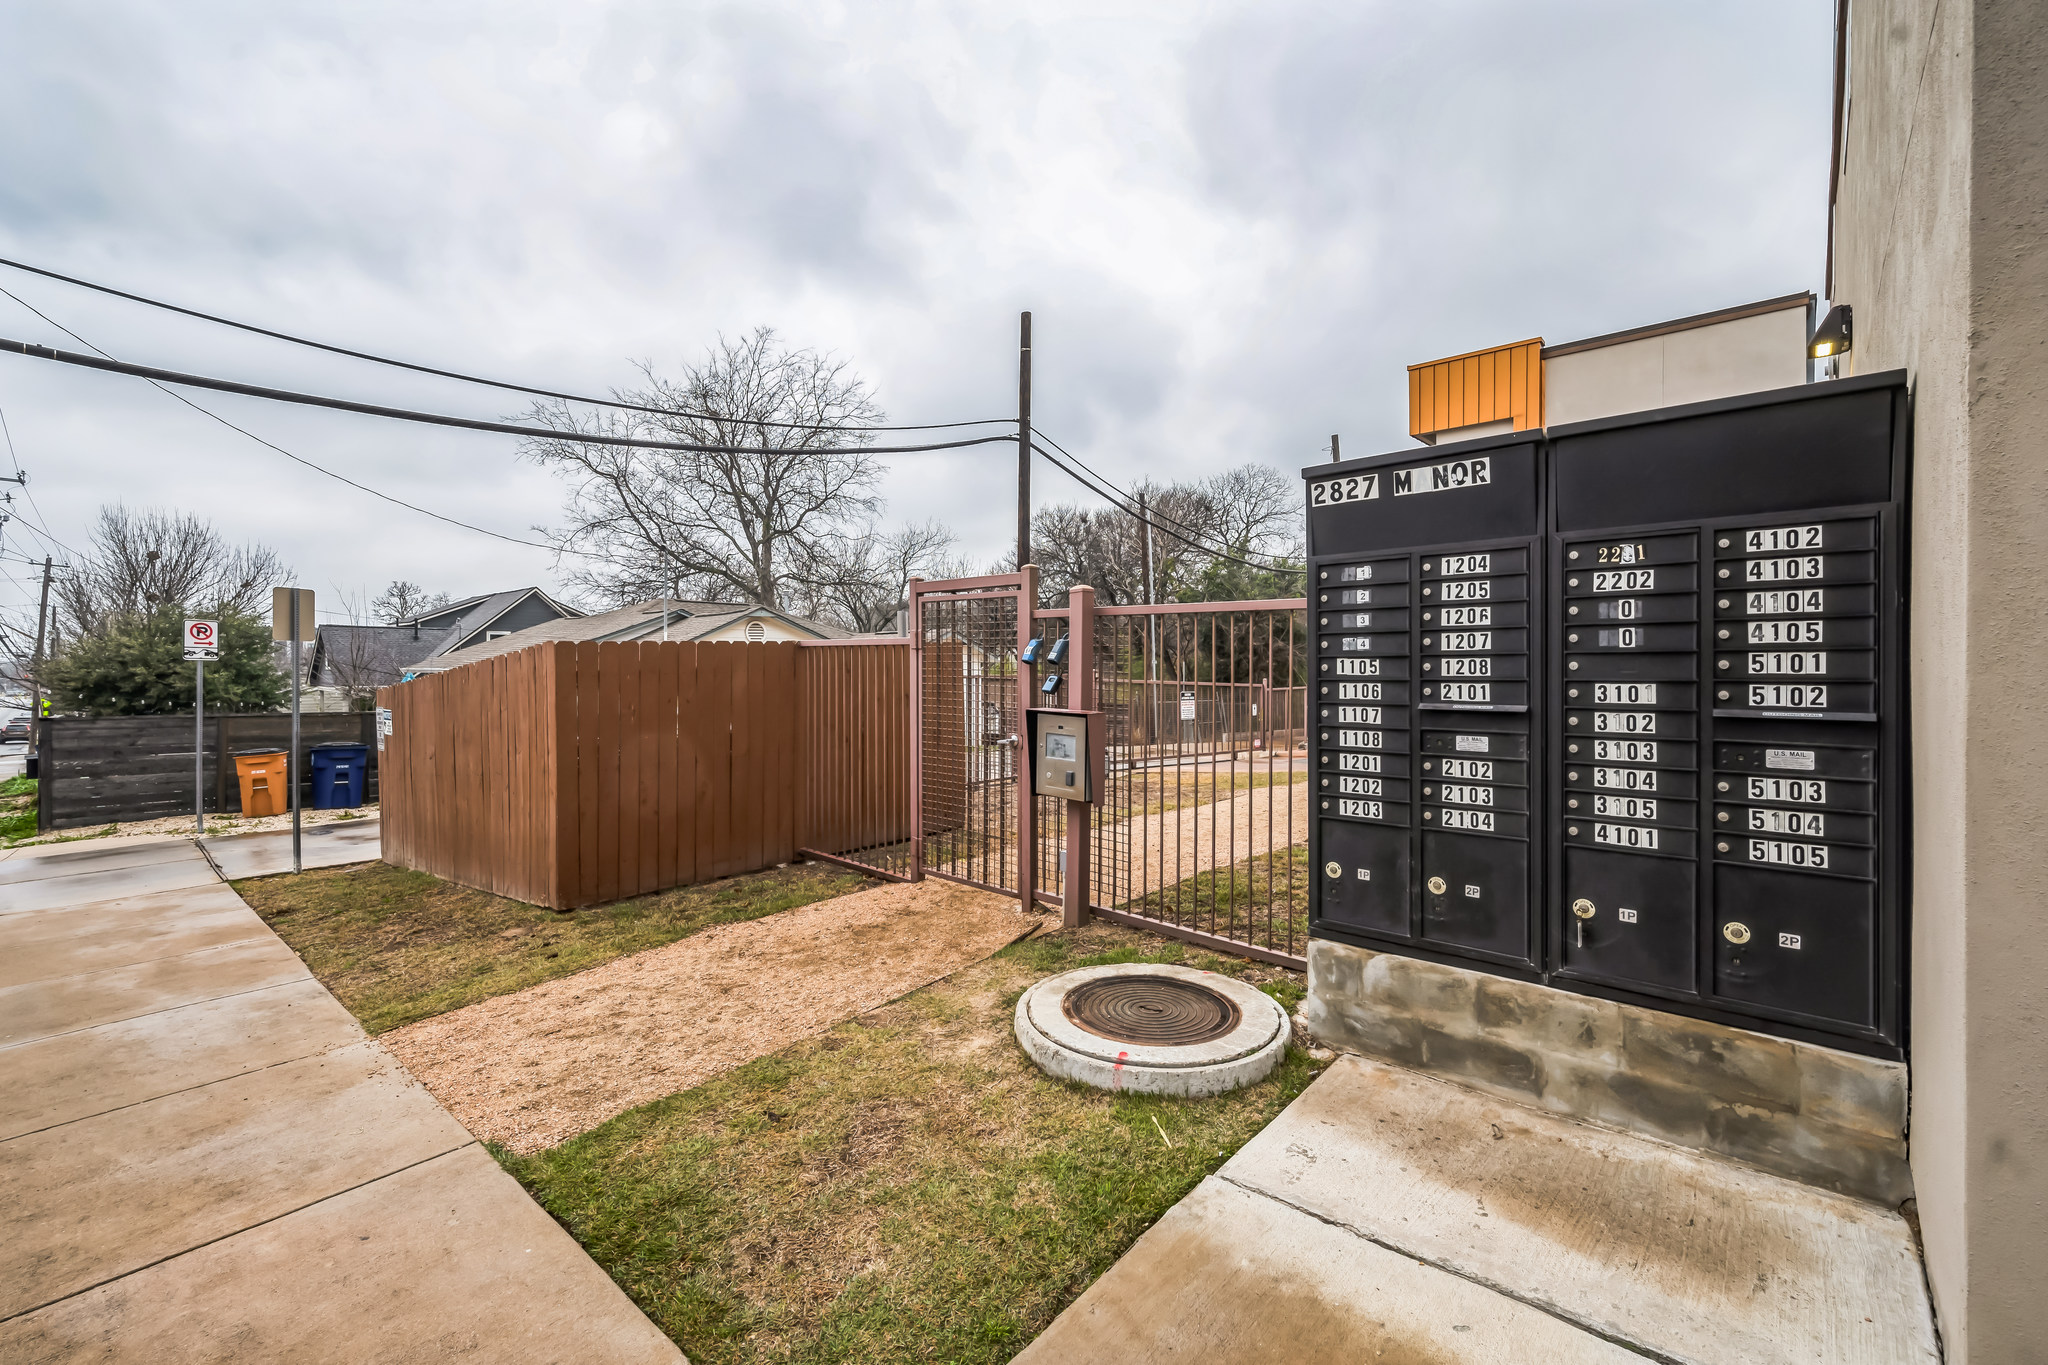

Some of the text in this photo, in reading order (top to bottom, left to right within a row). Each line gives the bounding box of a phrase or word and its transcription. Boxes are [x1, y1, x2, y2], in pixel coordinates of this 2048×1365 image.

[1314, 460, 1487, 505] 2827 MNOR
[1749, 528, 1820, 549] 4102
[1445, 556, 1487, 573] 1204
[1749, 558, 1820, 579] 4103
[1596, 571, 1651, 590] 2202
[1445, 582, 1488, 599] 1205
[1621, 601, 1631, 617] 0
[1750, 591, 1821, 612] 4104
[1445, 609, 1488, 624] 1206
[1623, 629, 1632, 646] 0
[1751, 622, 1820, 641] 4105
[1445, 634, 1488, 649] 1207
[1340, 660, 1377, 674] 1105
[1445, 660, 1488, 675] 1208
[1752, 653, 1821, 672] 5101
[1342, 684, 1379, 698] 1106
[1443, 684, 1487, 700] 2101
[1597, 685, 1652, 702] 3101
[1752, 686, 1824, 706] 5102
[1342, 708, 1379, 723] 1107
[1598, 714, 1653, 731] 3102
[1343, 731, 1379, 747] 1108
[1598, 742, 1654, 760] 3103
[1343, 755, 1378, 771] 1201
[1444, 761, 1490, 778] 2102
[1343, 778, 1379, 794] 1202
[1597, 769, 1654, 789] 3104
[1444, 786, 1491, 804] 2103
[1751, 779, 1822, 801] 5103
[1343, 801, 1380, 817] 1203
[1597, 797, 1654, 818] 3105
[1444, 811, 1491, 829] 2104
[1752, 811, 1822, 834] 5104
[1597, 825, 1653, 847] 4101
[1752, 841, 1825, 866] 5105
[1467, 887, 1478, 895] 2P
[1621, 911, 1635, 920] 1P
[1781, 936, 1799, 946] 2P
